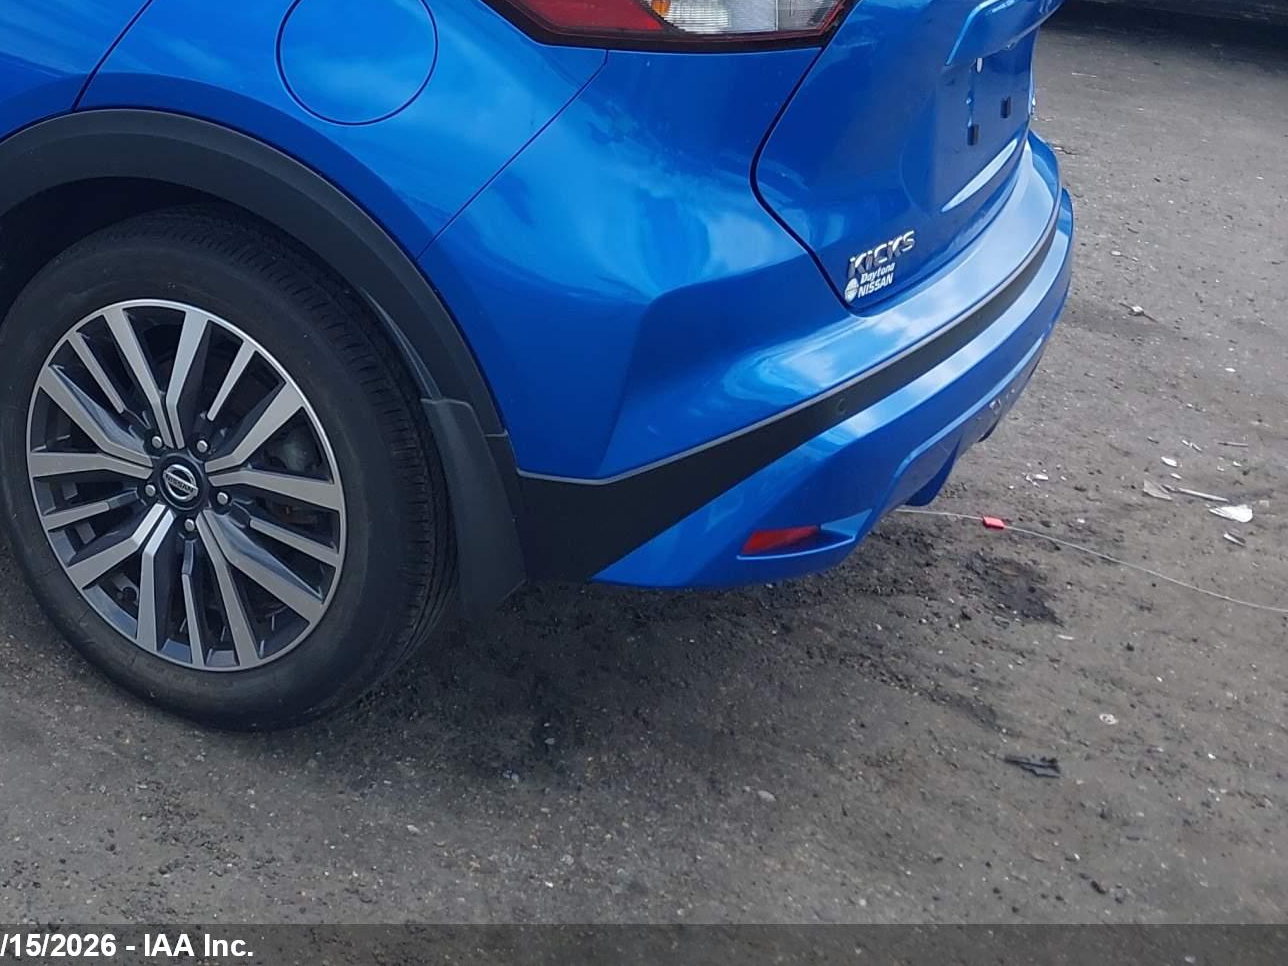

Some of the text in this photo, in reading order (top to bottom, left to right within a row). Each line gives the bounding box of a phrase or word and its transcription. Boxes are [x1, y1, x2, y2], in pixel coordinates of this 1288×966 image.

[848, 230, 916, 280] KICKS
[857, 273, 894, 299] NISSAN
[859, 261, 896, 285] Daytona
